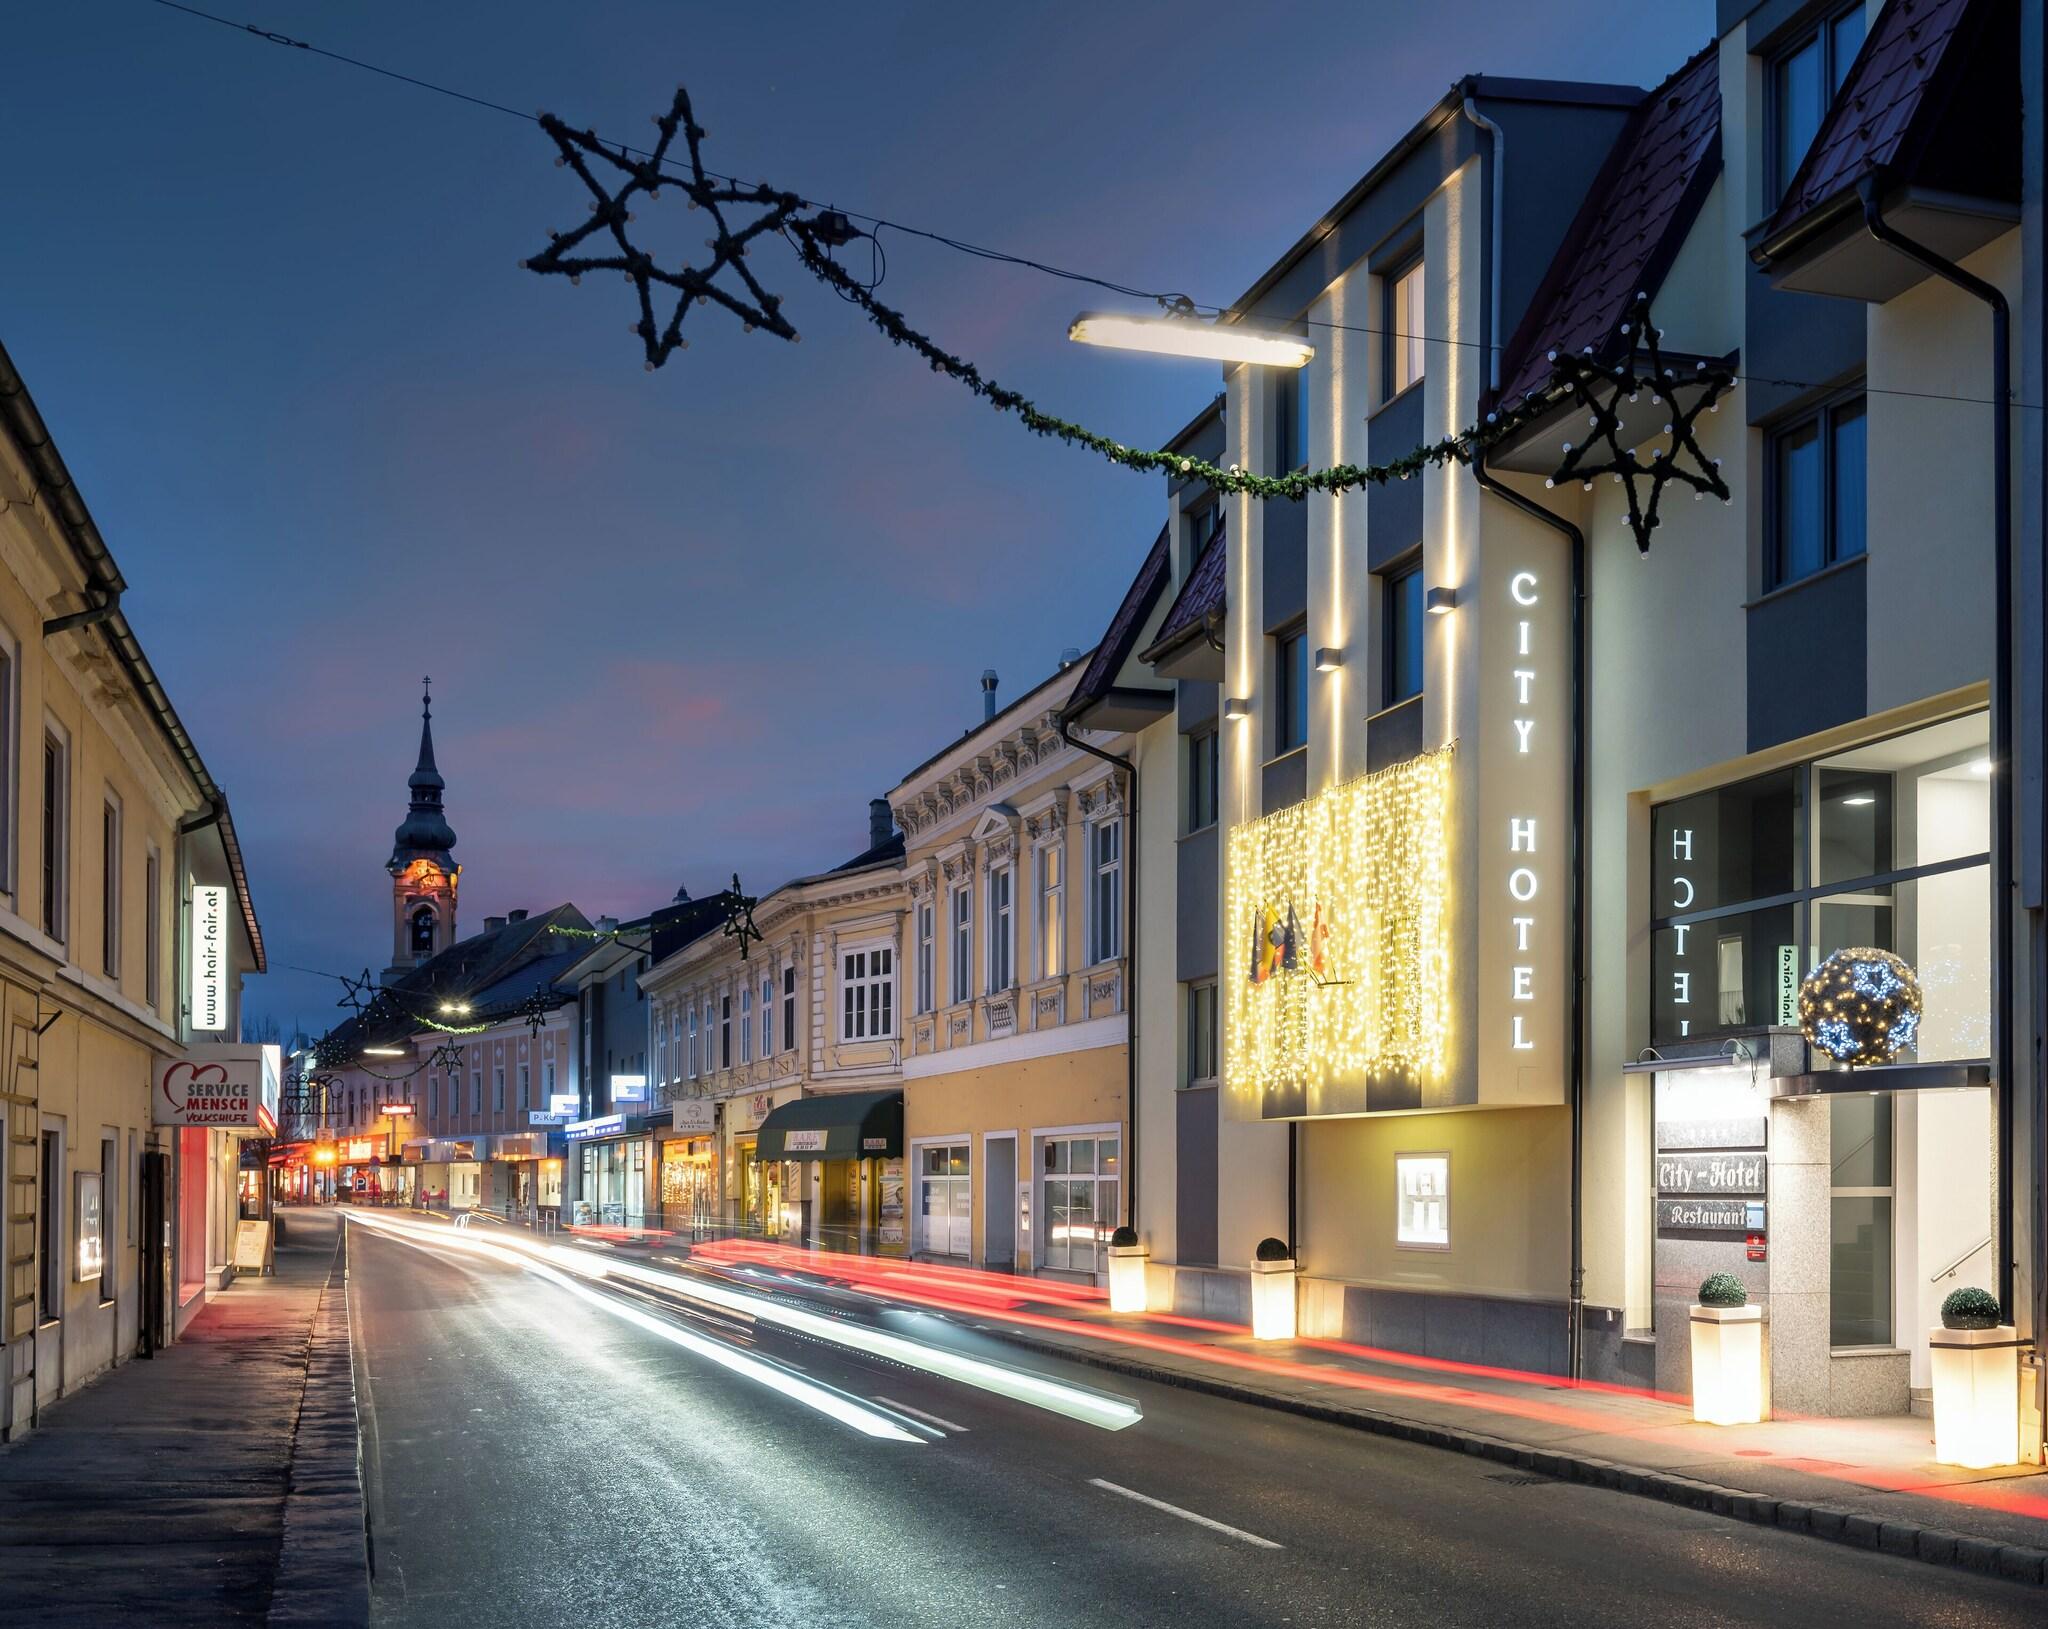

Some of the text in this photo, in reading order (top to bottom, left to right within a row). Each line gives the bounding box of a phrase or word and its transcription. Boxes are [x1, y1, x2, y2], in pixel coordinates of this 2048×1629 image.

[1509, 572, 1538, 1049] CITY HOTEL
[203, 891, 217, 1026] www.hair-fair.at
[187, 1084, 249, 1097] SERVICE
[186, 1097, 249, 1111] MENSCH
[1671, 1206, 1746, 1225] Restaurant
